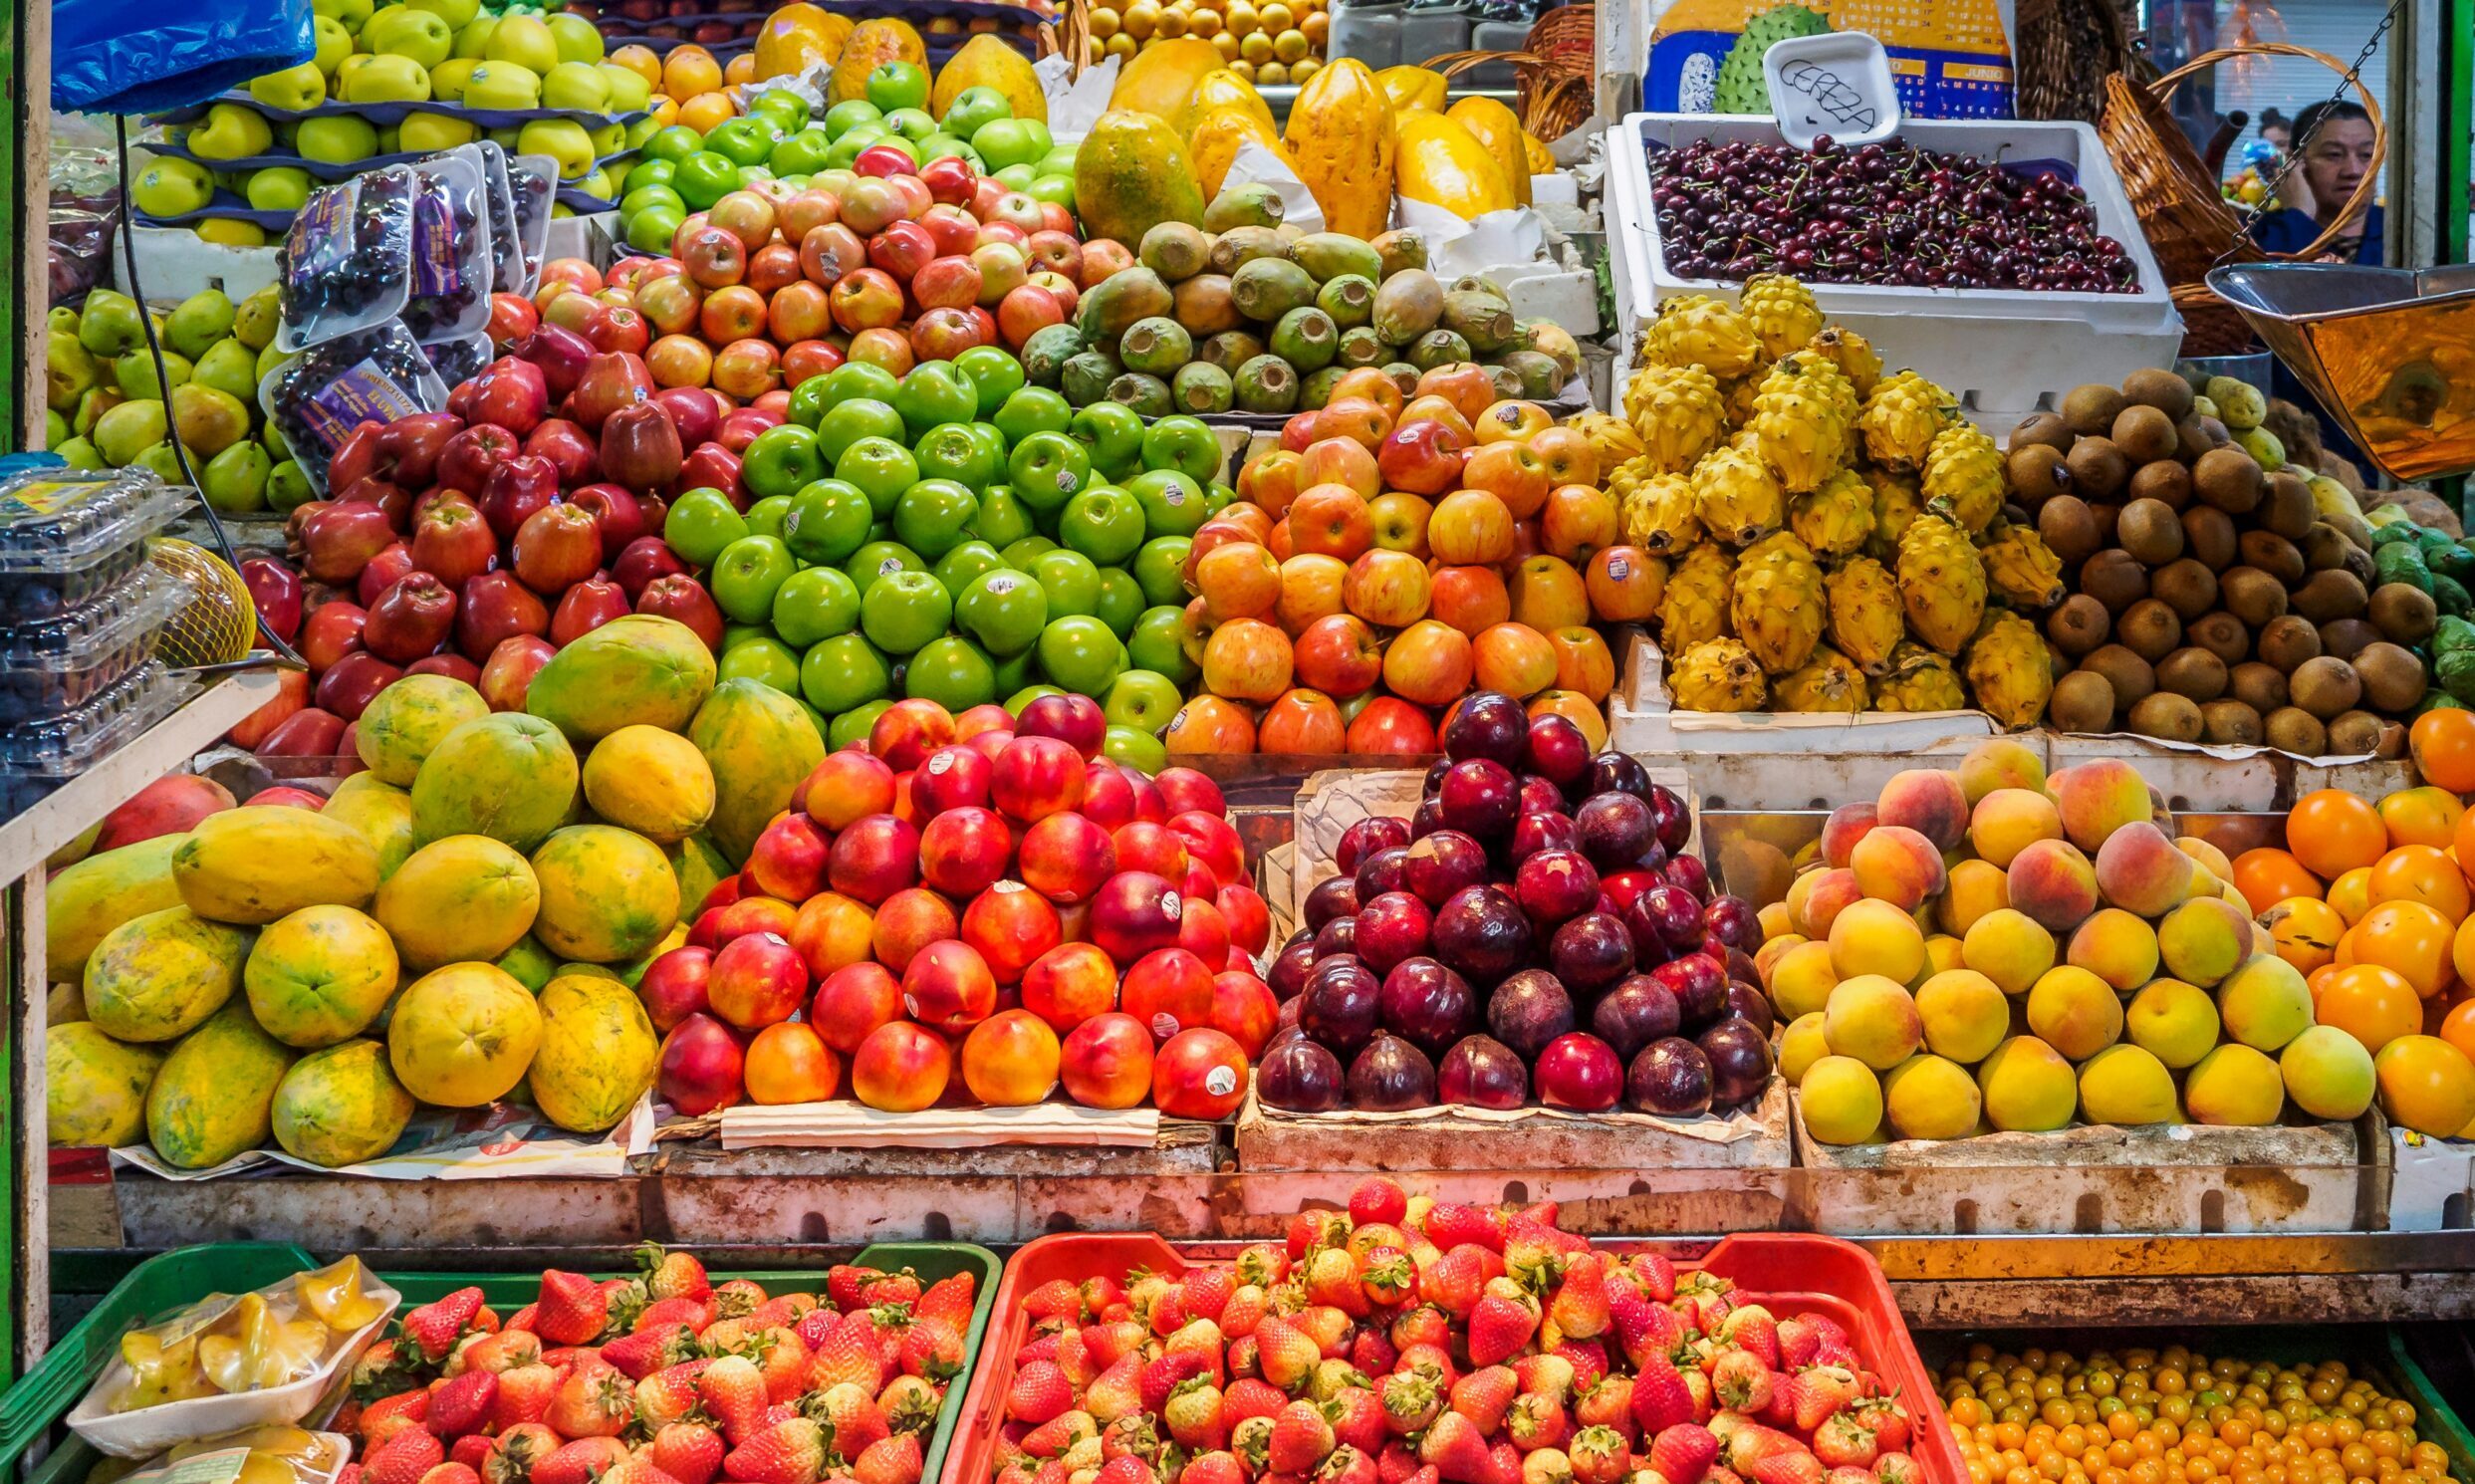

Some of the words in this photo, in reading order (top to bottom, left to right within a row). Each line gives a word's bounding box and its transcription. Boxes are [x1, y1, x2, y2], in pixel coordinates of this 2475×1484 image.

[1780, 59, 1875, 133] CEREZA
[1965, 68, 2004, 80] JUNIO
[358, 370, 417, 416] COMERCIALIZA
